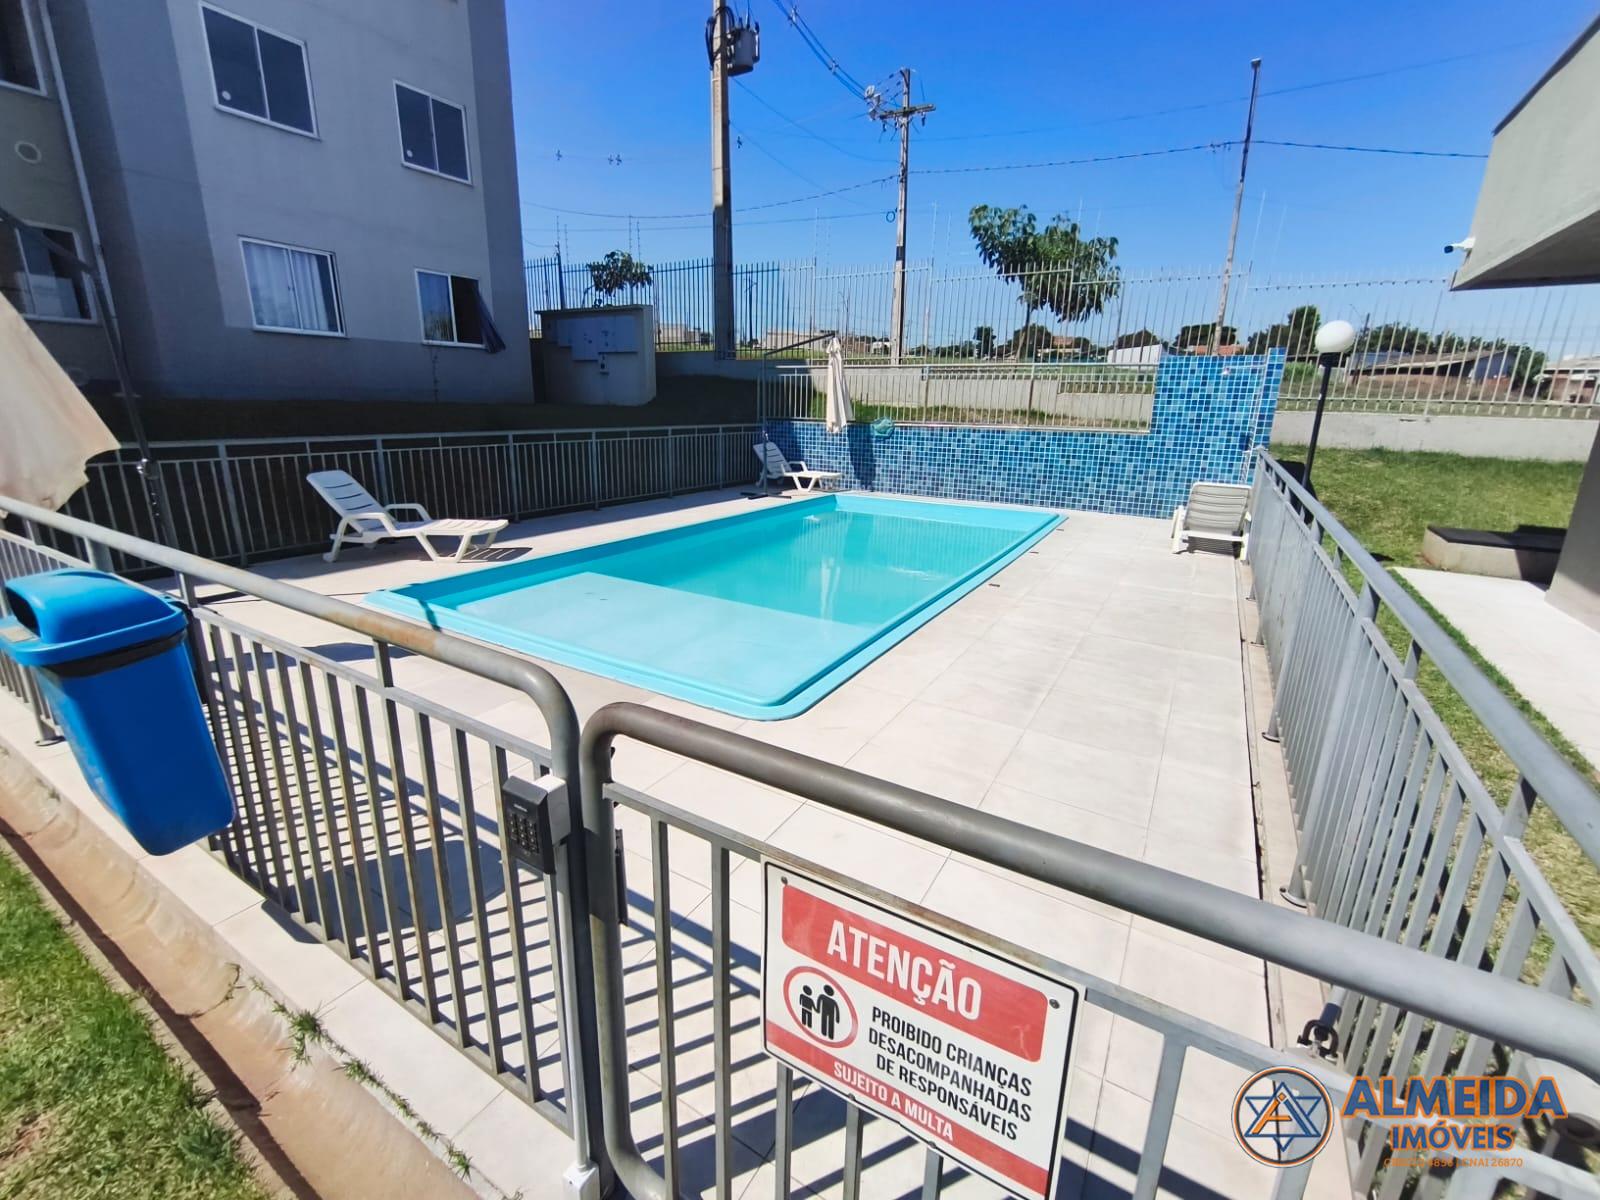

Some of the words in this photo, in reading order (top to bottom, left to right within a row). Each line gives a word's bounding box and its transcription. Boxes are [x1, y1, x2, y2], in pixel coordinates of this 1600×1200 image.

[826, 919, 982, 1021] ATENÇÃO
[869, 1027, 1032, 1122] DESACOMPANHADAS
[872, 1006, 942, 1054] PROIBIDO
[946, 1043, 1032, 1097] CRIANÇAS
[876, 1053, 895, 1077] DE
[899, 1064, 1018, 1140] RESPONSÁVEIS
[833, 1061, 888, 1102] SUJEITO
[891, 1091, 902, 1110] A
[904, 1099, 954, 1140] MULTA
